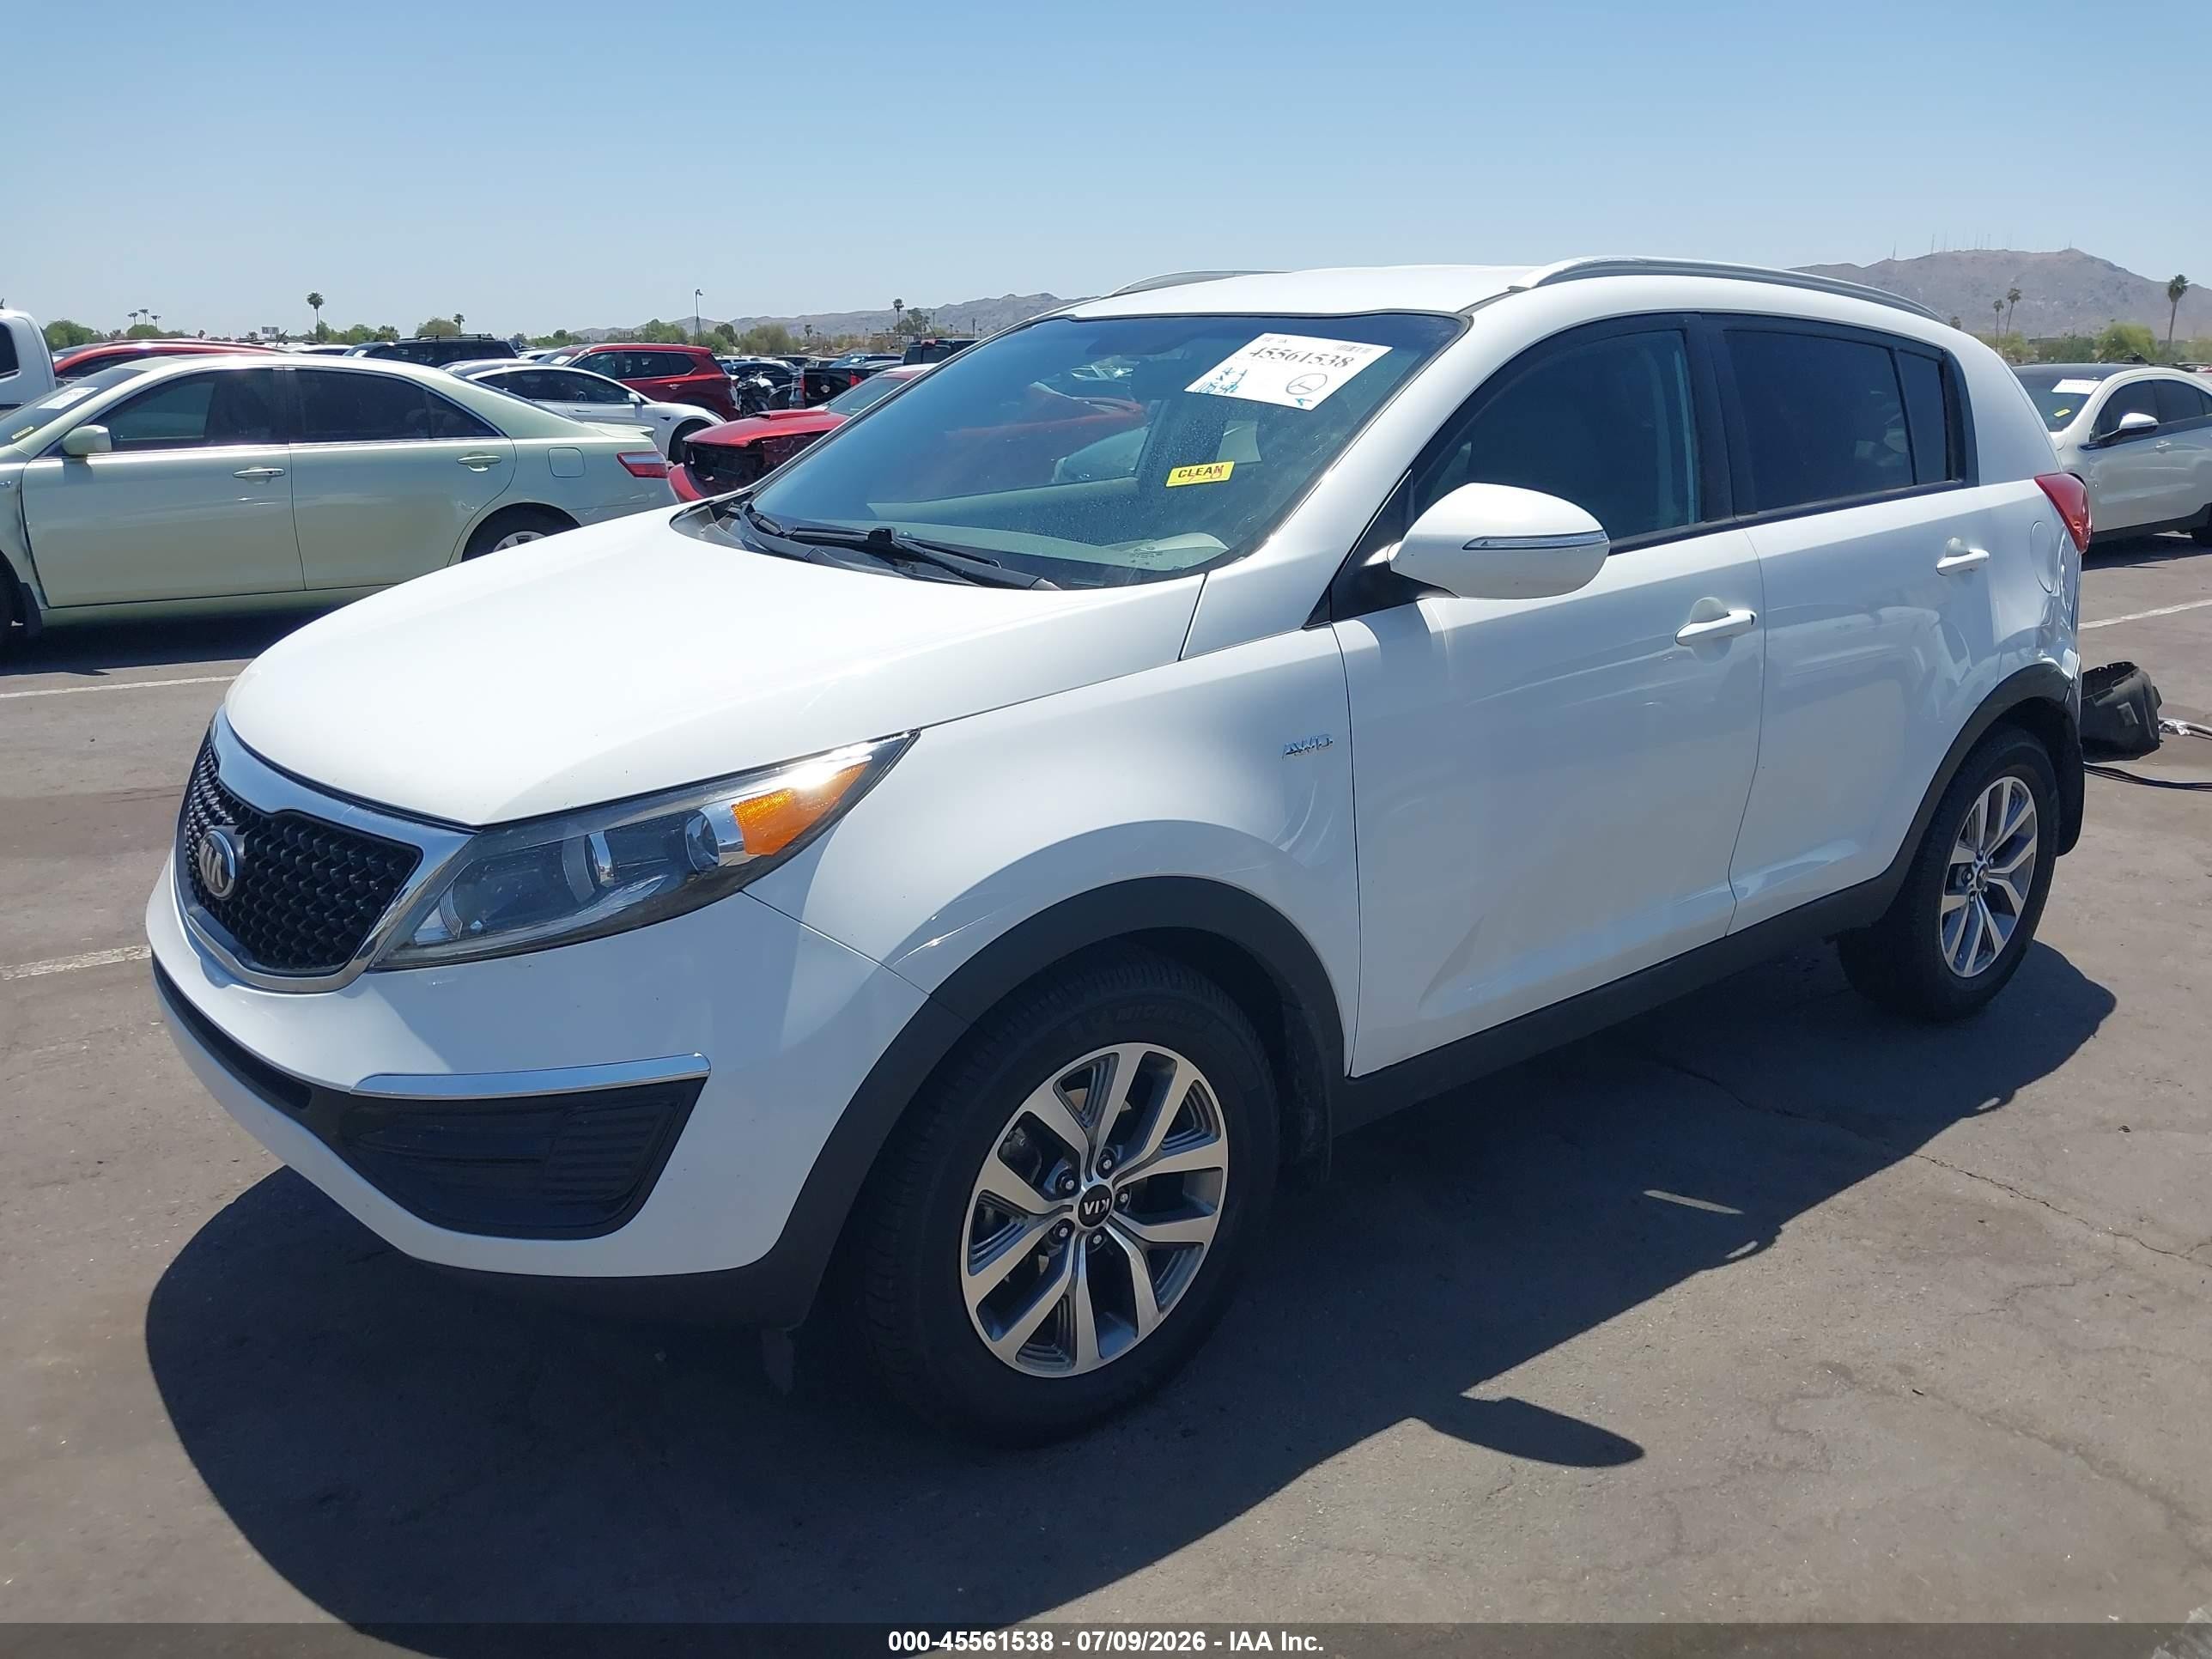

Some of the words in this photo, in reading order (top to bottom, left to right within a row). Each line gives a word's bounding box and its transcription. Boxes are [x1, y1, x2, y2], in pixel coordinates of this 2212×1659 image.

[1250, 346, 1354, 368] 45561538
[1177, 465, 1224, 478] CLEAN
[1084, 1197, 1110, 1215] KIA
